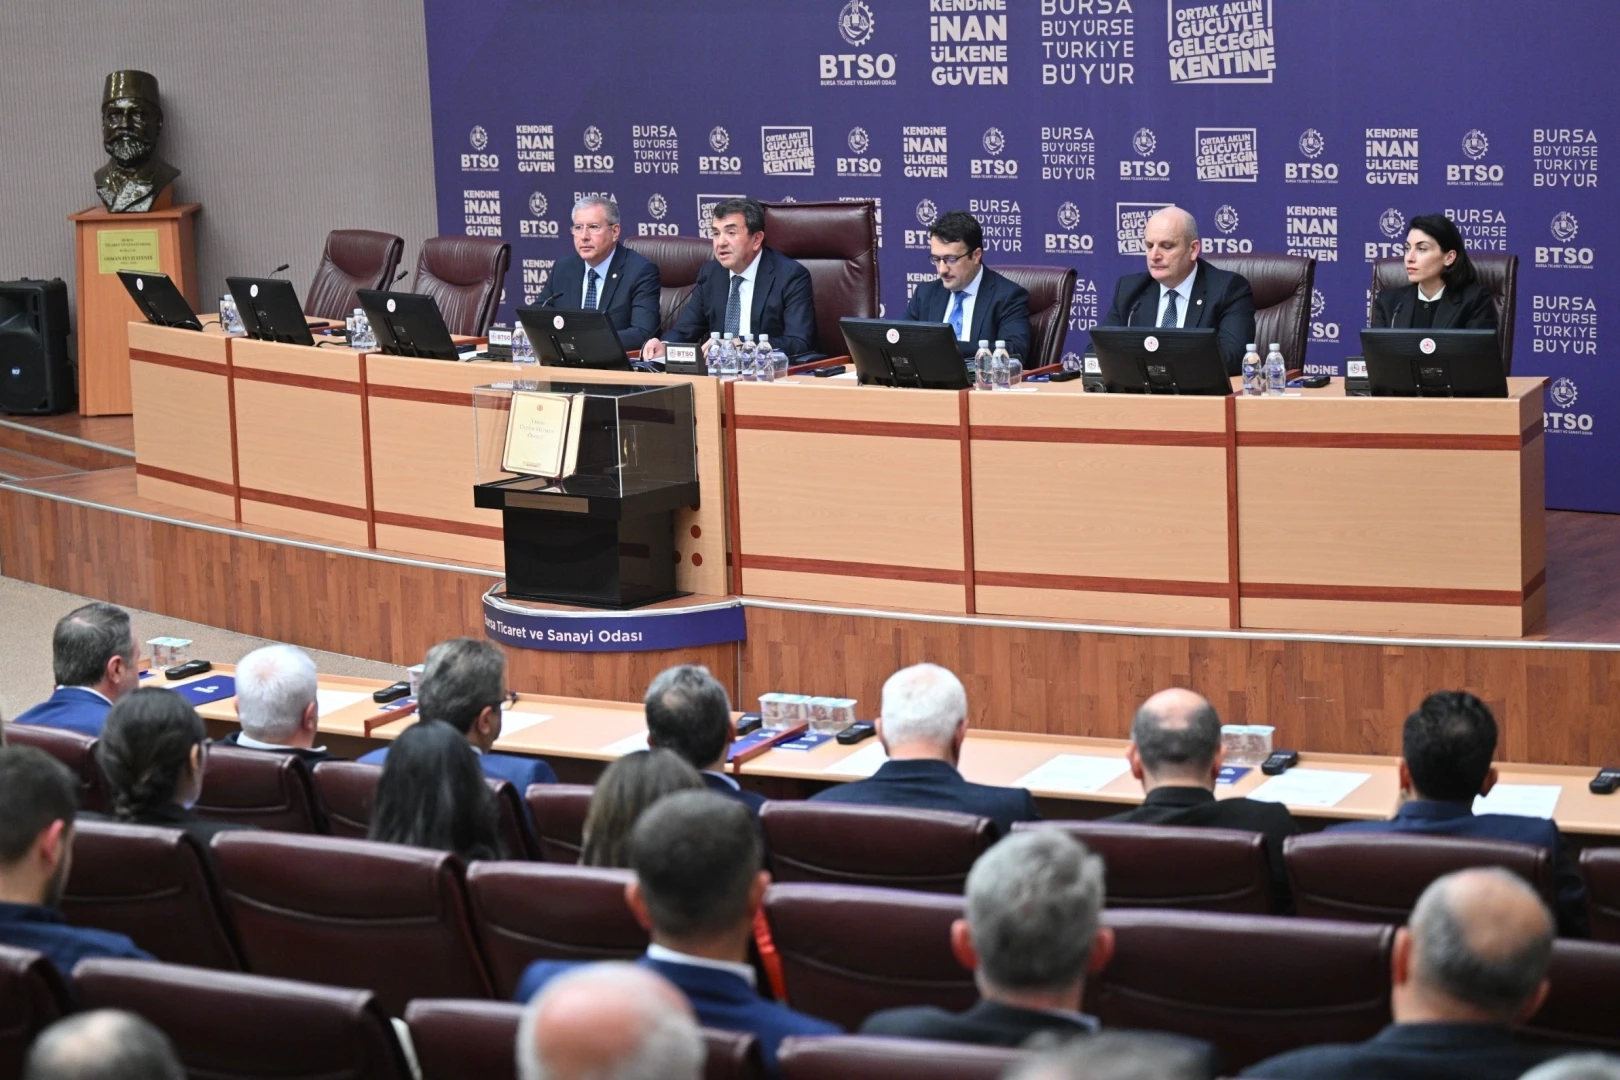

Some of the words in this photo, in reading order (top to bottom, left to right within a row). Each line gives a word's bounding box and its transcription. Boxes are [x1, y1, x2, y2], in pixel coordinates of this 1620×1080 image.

[1041, 0, 1133, 16] BURSA
[1176, 4, 1219, 22] ORTAK
[1222, 0, 1262, 16] AKLIN
[1042, 19, 1134, 36] BÜYÜRSE
[1177, 12, 1264, 39] GÜCÜYLE
[930, 46, 1008, 62] ÜLKENE
[1042, 40, 1134, 58] TÜRKİYE
[820, 54, 896, 78] BTSO
[932, 66, 1008, 85] GÜVEN
[1042, 63, 1134, 84] BÜYÜR
[633, 125, 677, 137] BURSA
[766, 133, 787, 143] ORTAK
[1041, 127, 1094, 140] BURSA
[1534, 129, 1597, 143] BURSA
[633, 139, 678, 148] BÜYÜRSE
[1201, 136, 1226, 145] ORTAK
[1228, 134, 1250, 143] AKLIN
[1042, 142, 1095, 152] BÜYÜRSE
[1534, 146, 1598, 156] BÜYÜRSE
[461, 154, 499, 168] BTSO
[518, 151, 554, 160] ÜLKENE
[574, 155, 614, 169] BTSO
[904, 154, 947, 165] ÜLKENE
[518, 162, 555, 172] GÜVEN
[634, 162, 679, 174] BÜYÜR
[699, 156, 741, 170] BTSO
[837, 158, 881, 173] BTSO
[971, 159, 1017, 175] BTSO
[1120, 161, 1170, 176] BTSO
[1366, 160, 1418, 170] ÜLKENE
[904, 166, 948, 178] GÜVEN
[1042, 167, 1095, 180] BÜYÜR
[1285, 163, 1338, 179] BTSO
[1447, 165, 1504, 181] BTSO
[1366, 172, 1418, 185] GÜVEN
[1534, 173, 1597, 187] BÜYÜR
[970, 200, 1021, 213] BURSA
[465, 216, 501, 225] ÜLKENE
[1121, 211, 1146, 220] ORTAK
[1445, 209, 1506, 223] BURSA
[466, 226, 502, 237] GÜVEN
[520, 220, 558, 234] BTSO
[638, 223, 679, 236] BTSO
[983, 239, 1021, 252] ÜYÜR
[1045, 234, 1093, 250] BTSO
[1202, 238, 1252, 254] BTSO
[1287, 236, 1337, 248] ÜLKENE
[1464, 239, 1506, 250] RKİYE
[1365, 242, 1404, 258] BTS
[1535, 247, 1594, 264] BTSO
[523, 259, 555, 268] KENDİN
[523, 269, 551, 283] İNA
[907, 273, 940, 282] KENDİ
[1533, 296, 1596, 311] BURSA
[1069, 319, 1097, 331] YÜR
[1533, 312, 1597, 324] BÜYÜRSE
[1533, 339, 1596, 355] BÜYÜR
[1303, 364, 1338, 375] NDİNE
[497, 620, 526, 638] Ticaret
[530, 630, 543, 640] ve
[548, 630, 593, 644] Sanayi
[598, 630, 642, 642] Odası
